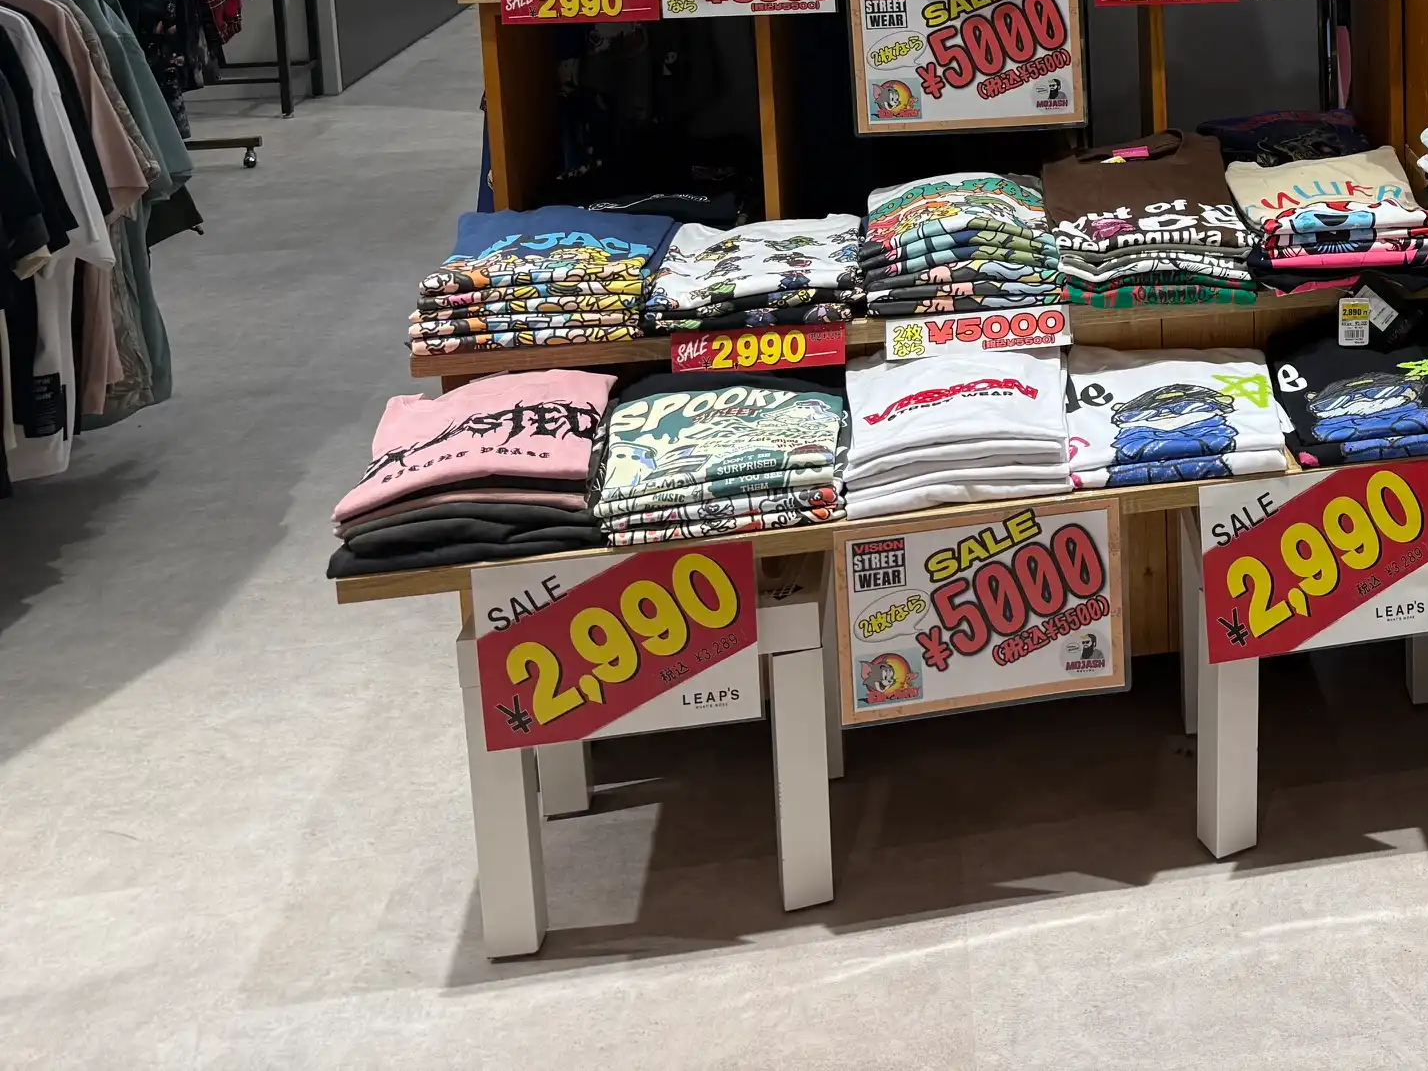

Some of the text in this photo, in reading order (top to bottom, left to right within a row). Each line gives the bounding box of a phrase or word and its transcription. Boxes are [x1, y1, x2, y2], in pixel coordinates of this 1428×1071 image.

[866, 0, 905, 12] STREET
[870, 14, 903, 27] WEAR
[871, 36, 923, 66] 2枚なら
[925, 310, 1065, 345] ¥5000
[677, 334, 709, 363] SALE
[893, 341, 925, 357] なら
[962, 390, 1013, 398] WEAR
[610, 386, 798, 433] SPOOKY
[717, 459, 777, 476] SURPRISED
[739, 474, 760, 483] YOU
[740, 483, 769, 493] THEM
[653, 493, 685, 503] MUSIC
[1211, 491, 1280, 547] SALE
[854, 539, 904, 552] VISION
[925, 508, 1042, 583] SALE
[853, 551, 904, 571] STREET
[1217, 470, 1424, 647] ¥2,990
[859, 570, 902, 588] WEAR
[487, 574, 568, 632] SALE
[916, 523, 1105, 672] ¥5000
[859, 594, 926, 638] 2枚なら
[1375, 600, 1425, 619] LEAP'S
[496, 553, 740, 733] ¥2,990
[659, 661, 690, 683] 税込
[682, 687, 740, 706] LEAP'S
